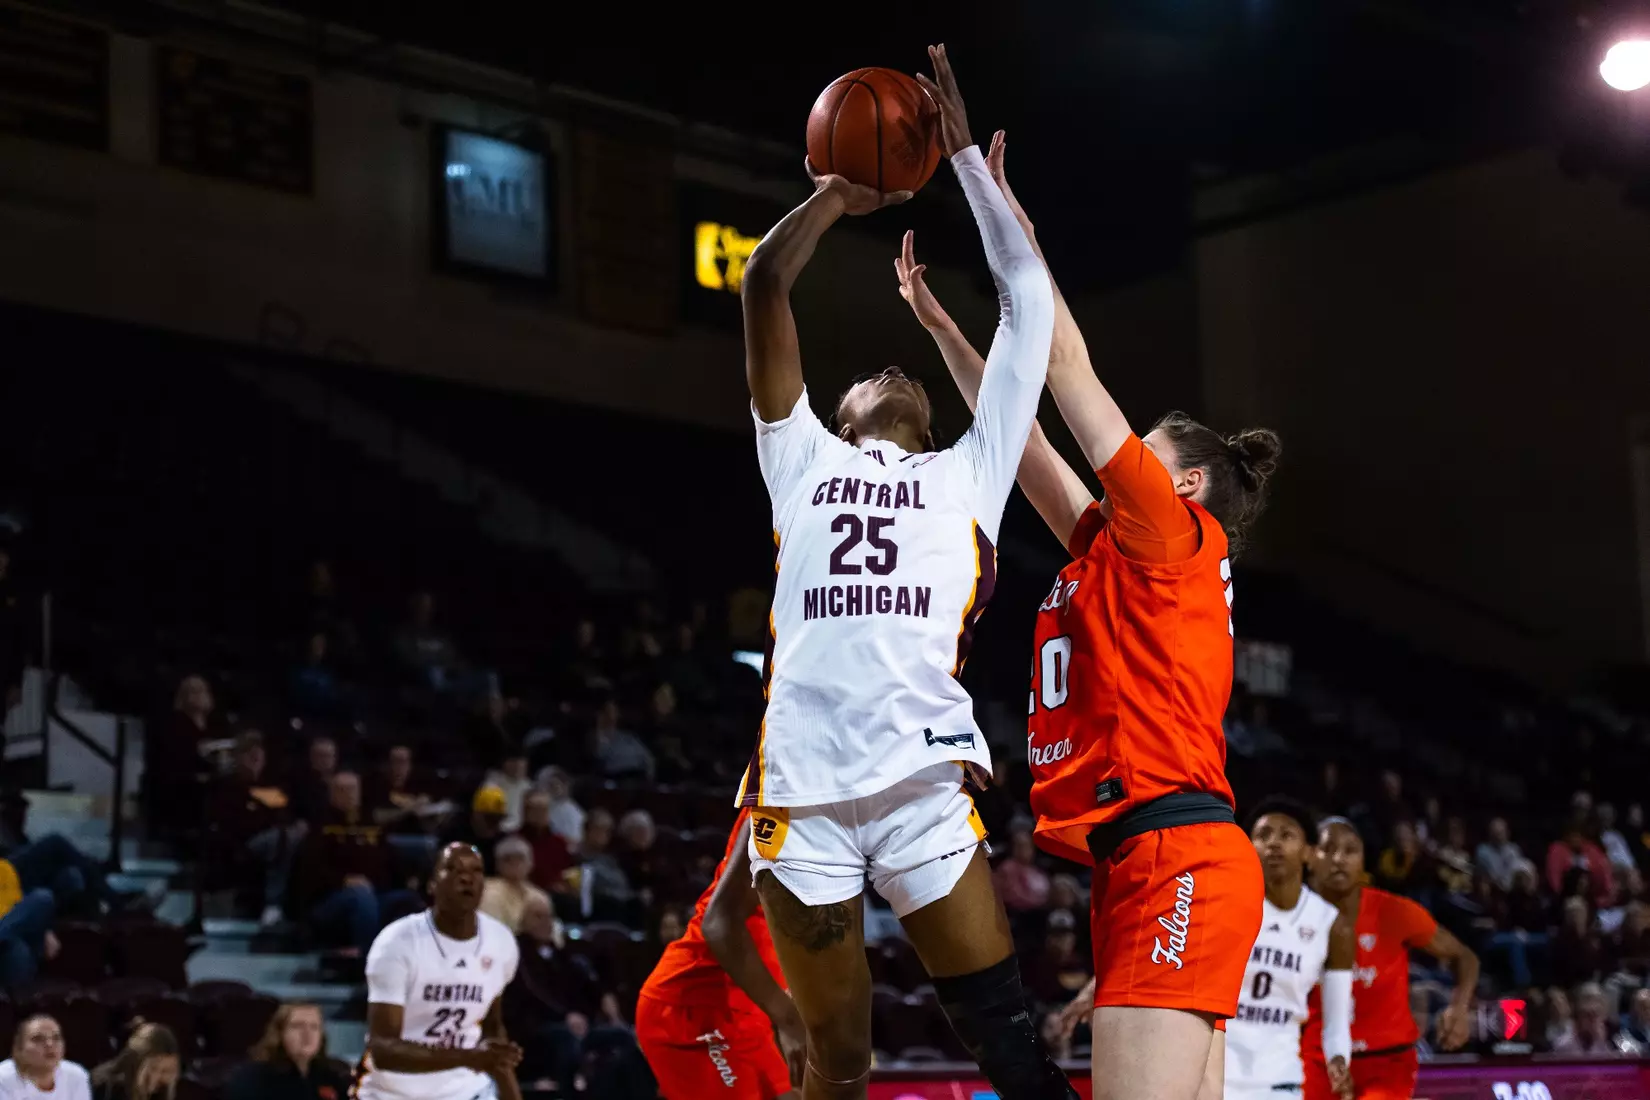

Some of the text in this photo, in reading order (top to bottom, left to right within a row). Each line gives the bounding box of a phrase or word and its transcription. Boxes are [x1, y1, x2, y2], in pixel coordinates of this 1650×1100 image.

[812, 477, 925, 509] CENTRAL
[829, 513, 899, 576] 25
[804, 585, 932, 621] MICHIGAN
[1028, 635, 1072, 715] 0
[1151, 871, 1195, 970] Falcons
[1252, 946, 1302, 973] NTRAL
[423, 984, 483, 1003] CENTRAL
[1251, 971, 1273, 1001] 0
